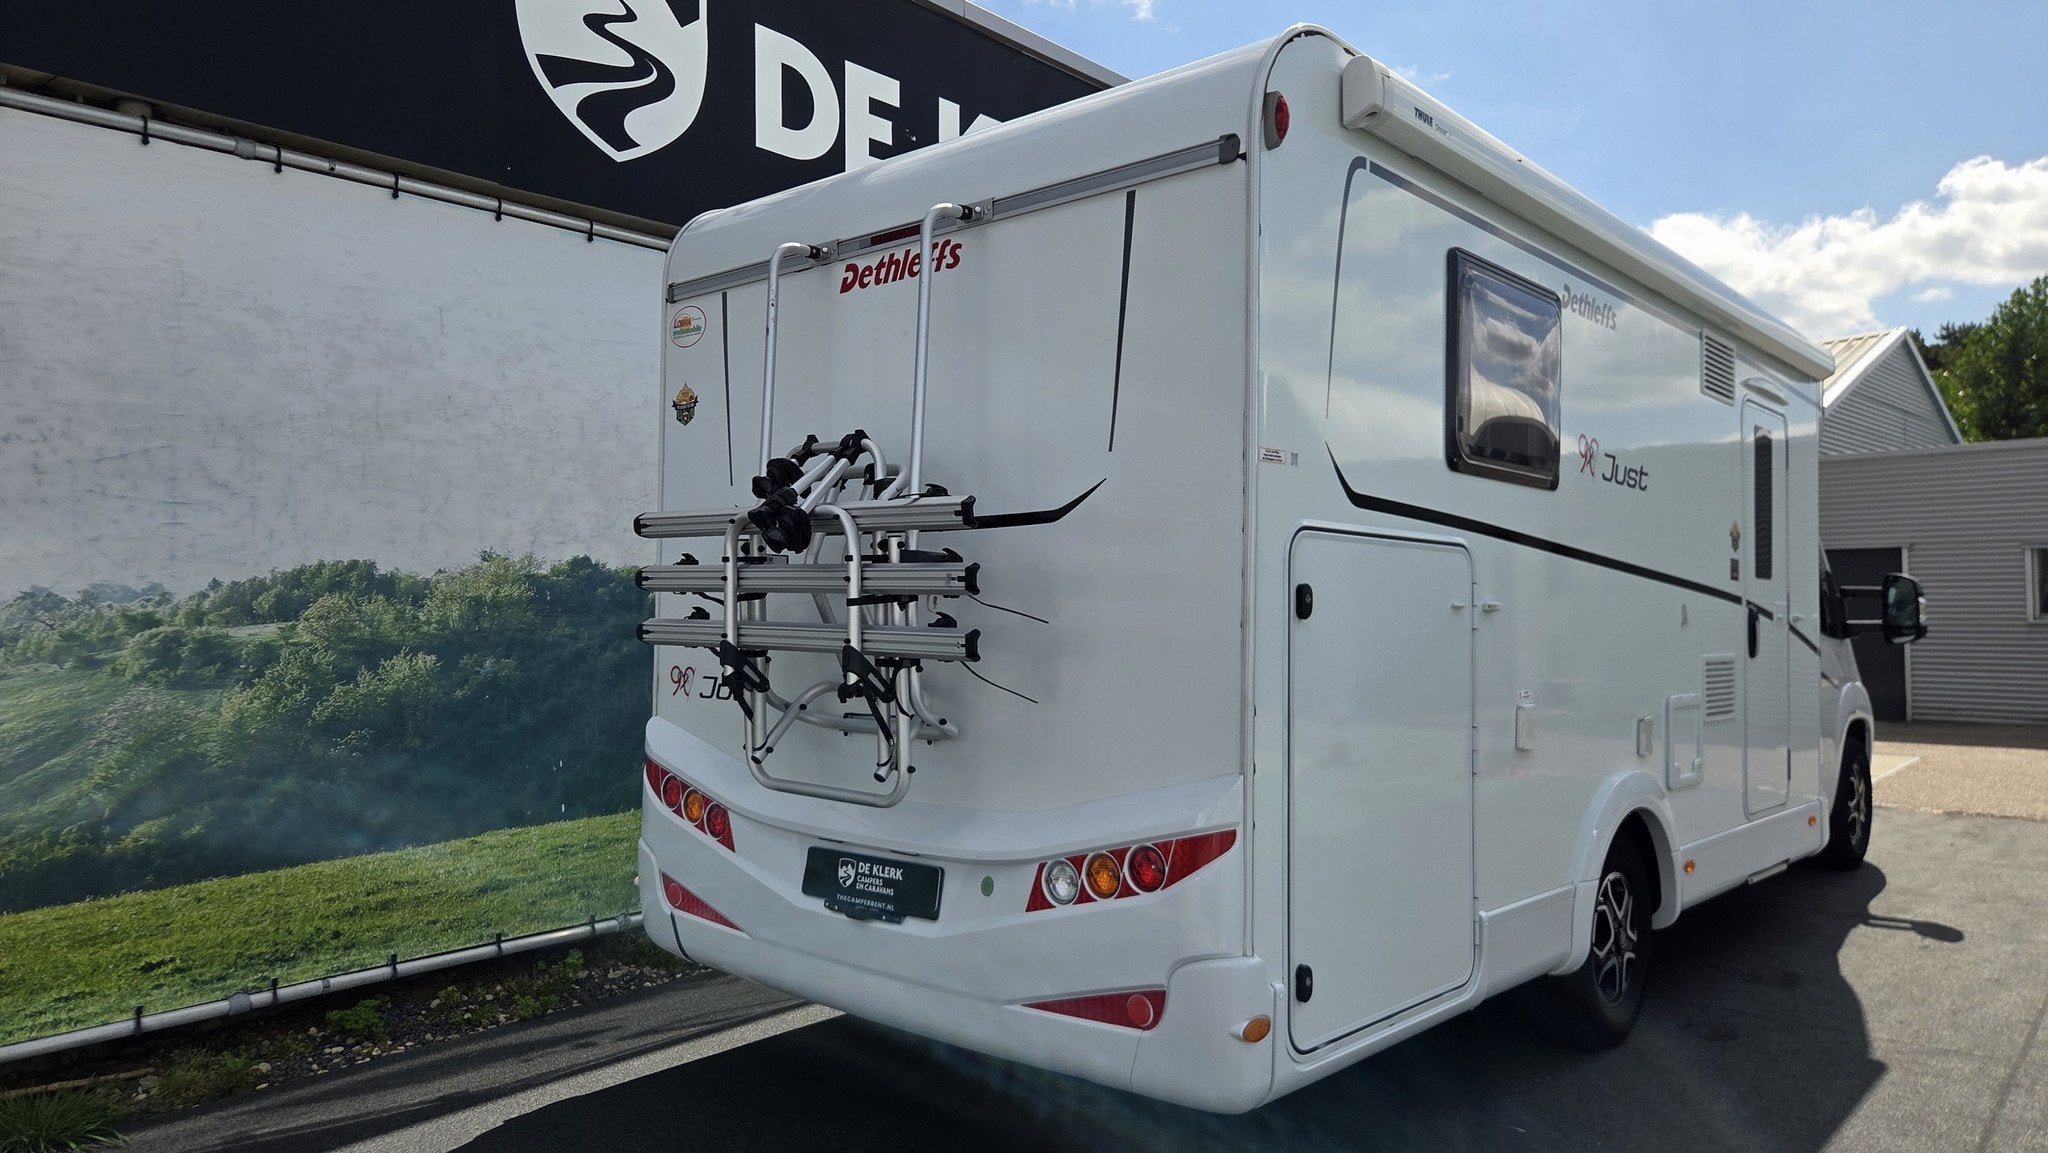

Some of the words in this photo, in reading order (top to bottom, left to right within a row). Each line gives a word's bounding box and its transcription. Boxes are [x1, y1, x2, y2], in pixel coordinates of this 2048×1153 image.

[755, 22, 900, 173] DE
[1414, 106, 1433, 128] THULE
[839, 239, 963, 294] Dethlefs
[1561, 283, 1617, 331] Dethleffs
[1602, 452, 1649, 491] Just
[700, 675, 733, 700] Ju
[856, 875, 883, 886] CAMPERS
[858, 861, 870, 875] DE
[872, 864, 904, 881] KLERK
[856, 882, 864, 890] EN
[864, 883, 894, 896] CARAVANS
[836, 893, 895, 911] THECAMPERRENT.NL
